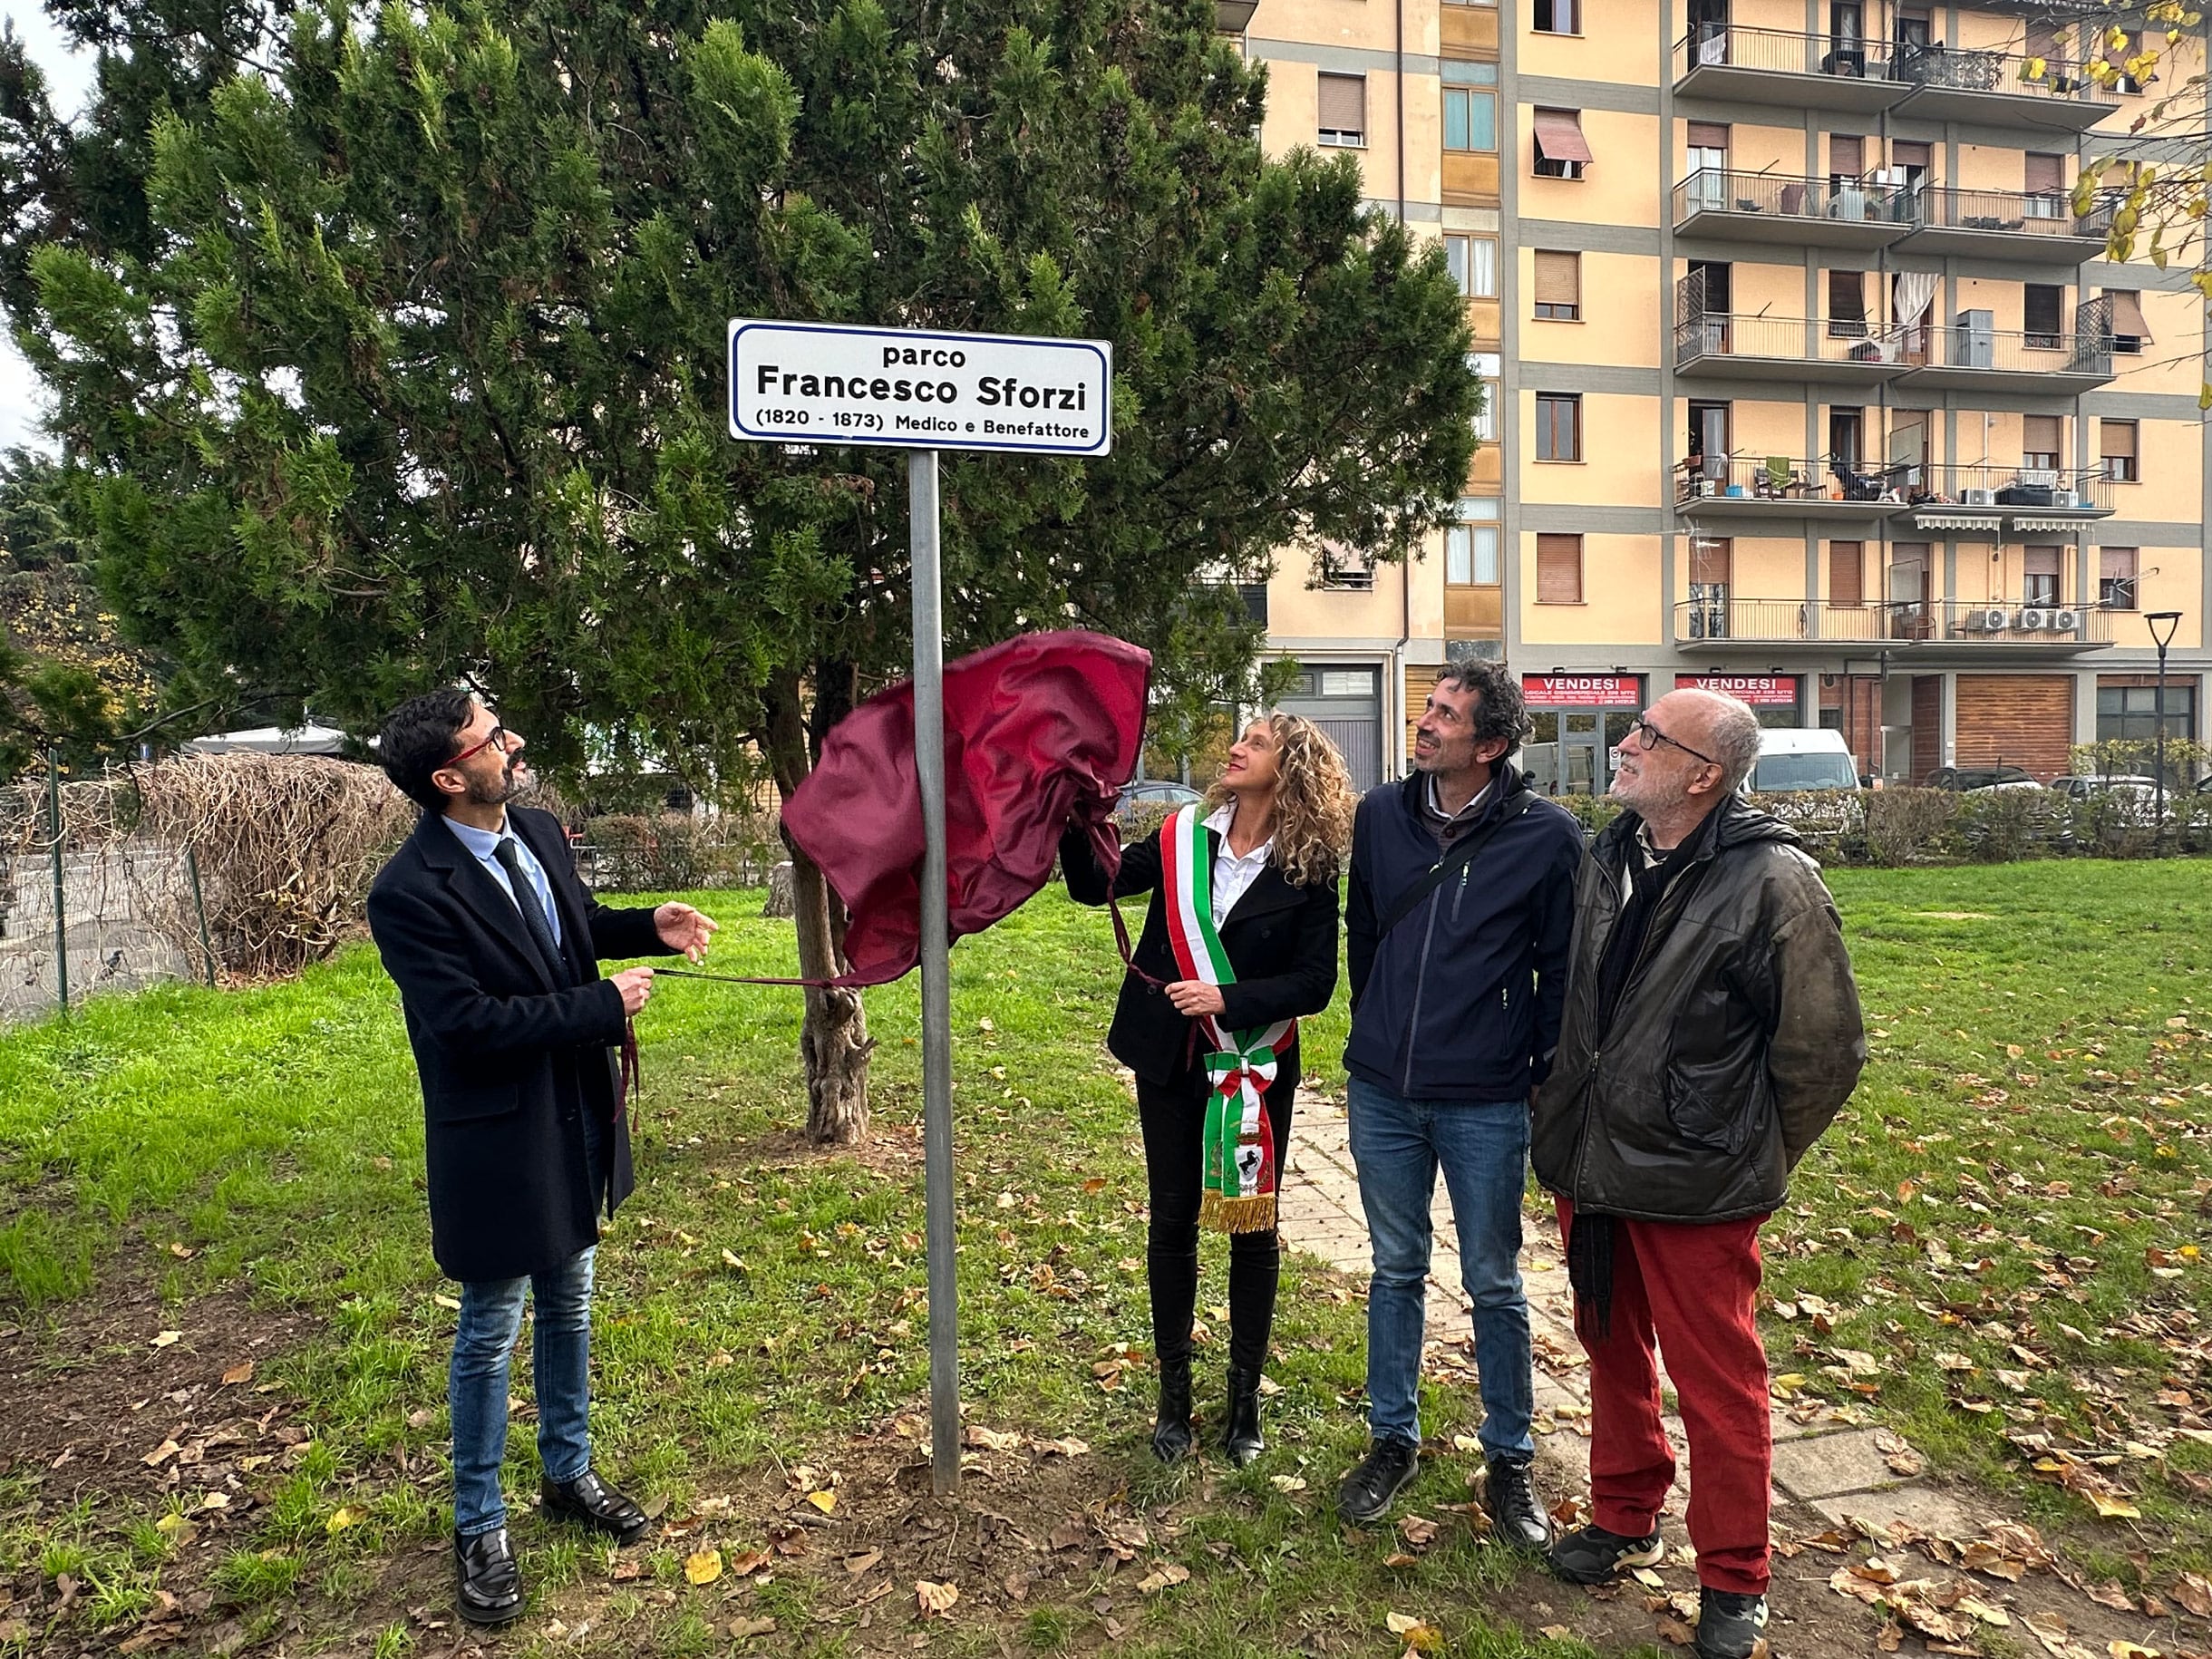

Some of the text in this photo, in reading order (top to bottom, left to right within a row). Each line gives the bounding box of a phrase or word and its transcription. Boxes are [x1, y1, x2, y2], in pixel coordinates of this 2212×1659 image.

[883, 347, 966, 368] parco
[758, 365, 1086, 411] Francesco Sforzi
[756, 409, 810, 427] (1820
[832, 412, 884, 432] 1873)
[896, 415, 957, 432] Medico
[965, 422, 975, 432] e
[984, 420, 1090, 438] Benefattore
[1543, 678, 1620, 690] VENDESI
[1696, 678, 1777, 690] VENDESI
